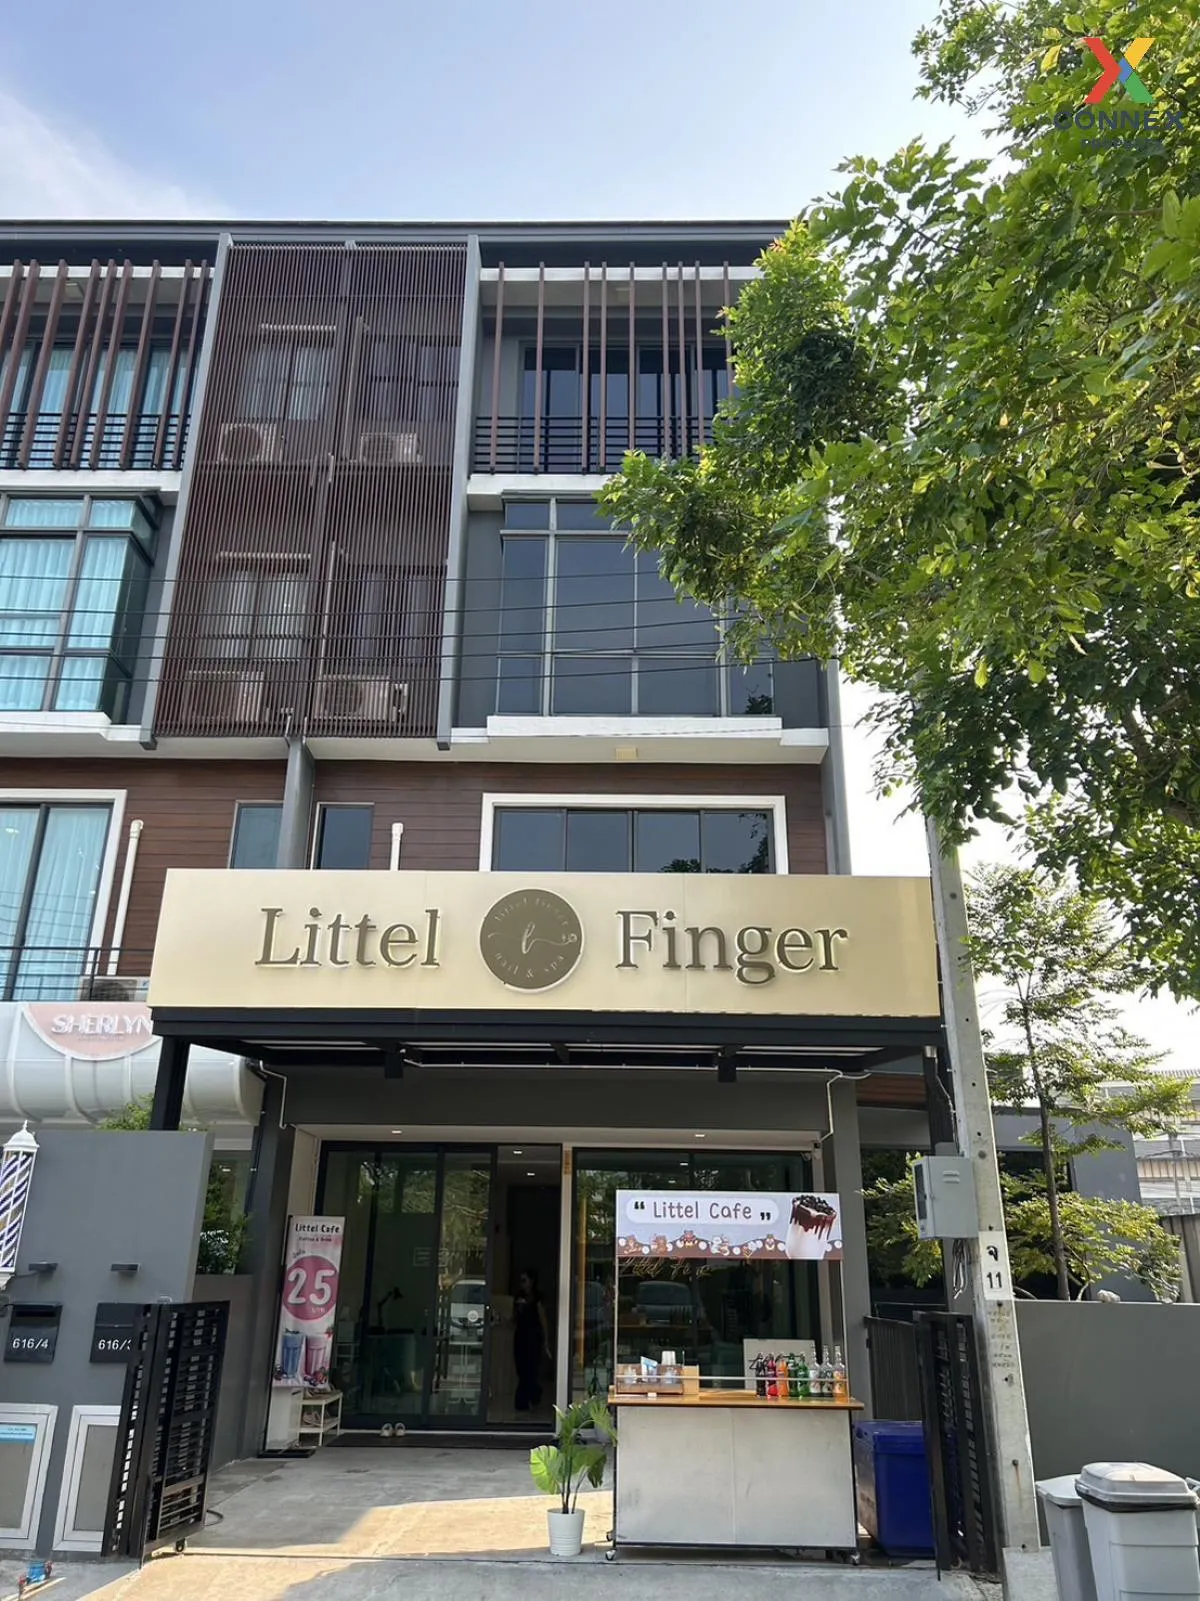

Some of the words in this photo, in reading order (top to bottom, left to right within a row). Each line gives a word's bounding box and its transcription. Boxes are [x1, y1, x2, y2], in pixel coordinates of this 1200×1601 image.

[254, 906, 441, 967] Littel
[615, 909, 848, 985] Finger
[51, 1013, 153, 1034] SHERLYN
[320, 1224, 341, 1234] Cafe
[287, 1267, 336, 1305] 25
[986, 1271, 1002, 1289] 11
[12, 1338, 49, 1349] 616/4
